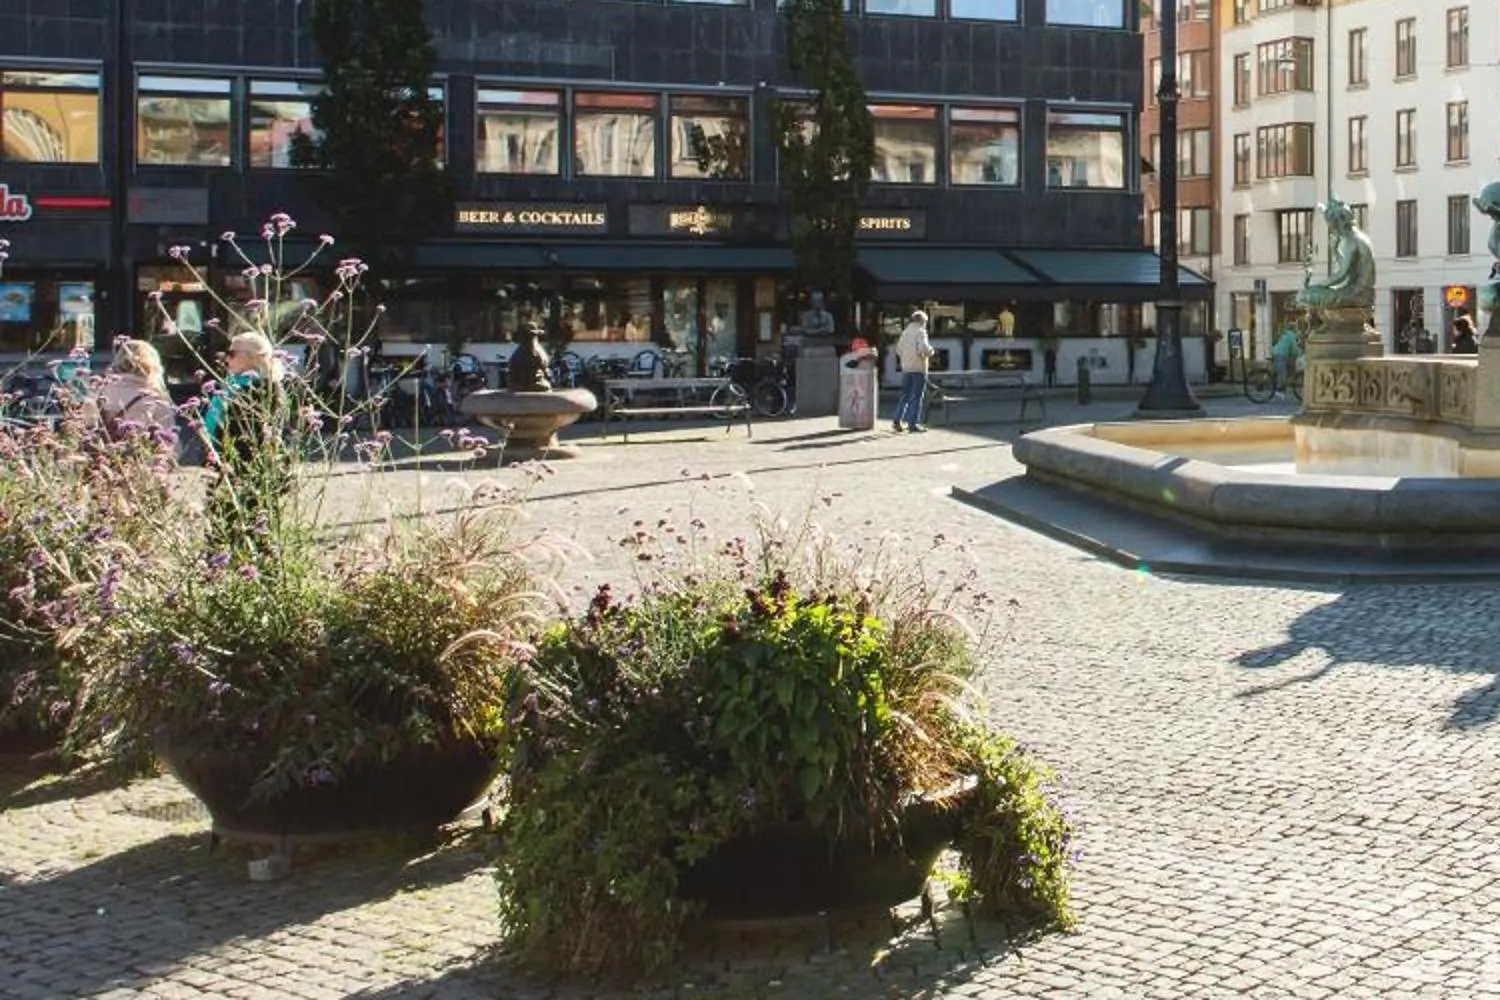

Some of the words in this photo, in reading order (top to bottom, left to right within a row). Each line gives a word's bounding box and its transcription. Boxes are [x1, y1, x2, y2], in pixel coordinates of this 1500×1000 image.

[458, 210, 499, 223] BEER
[503, 211, 515, 223] &
[519, 210, 605, 225] COCKTAILS
[859, 216, 911, 229] SPIRITS
